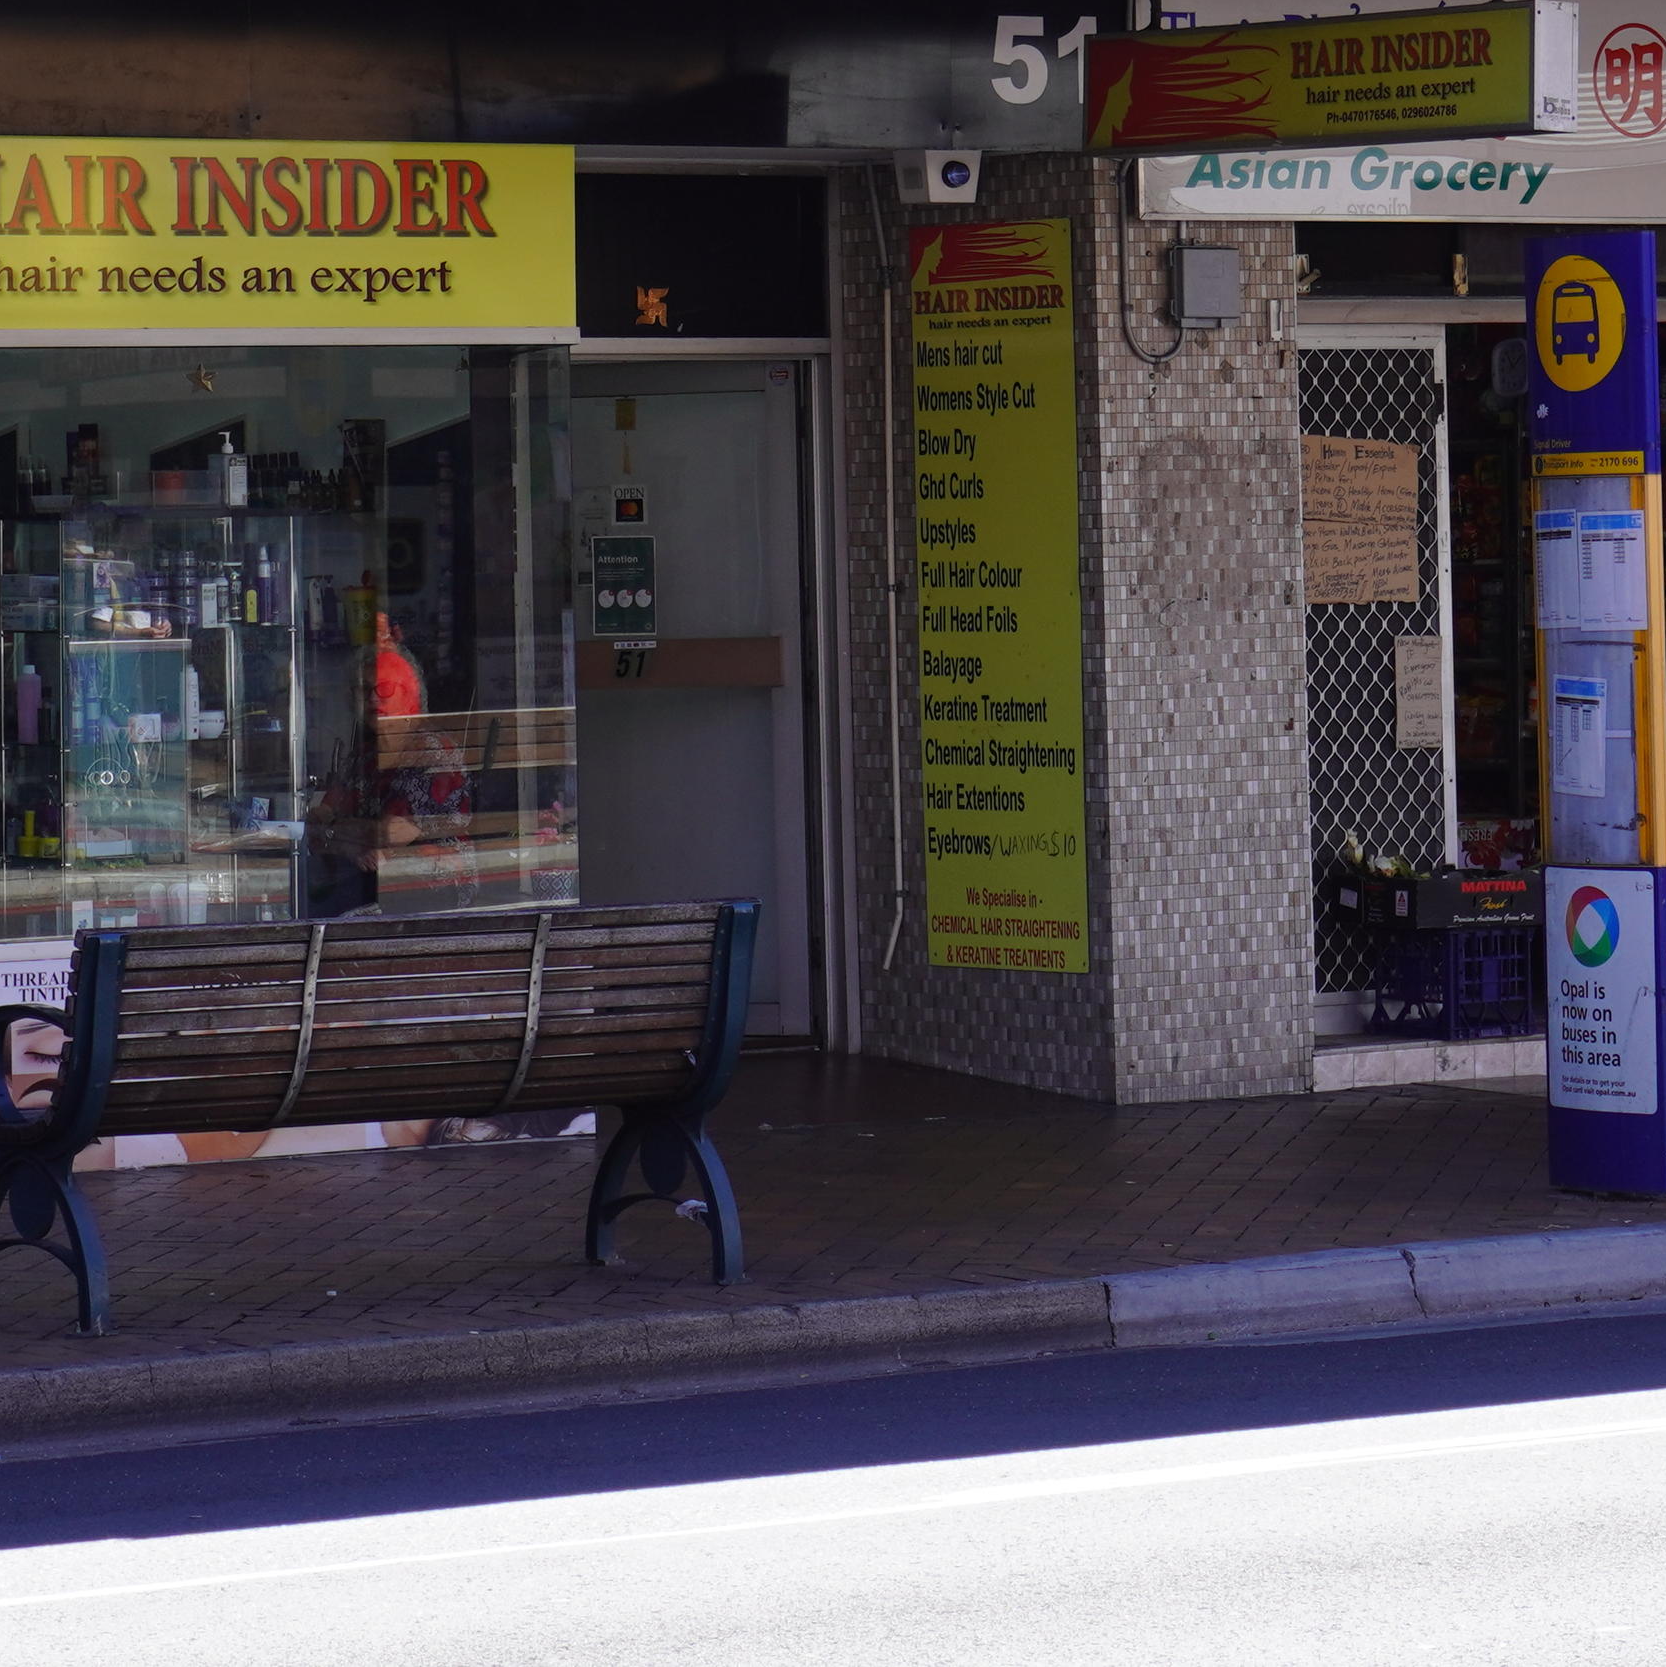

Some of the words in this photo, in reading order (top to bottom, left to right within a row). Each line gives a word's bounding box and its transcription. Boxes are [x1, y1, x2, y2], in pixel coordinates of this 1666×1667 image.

[989, 15, 1097, 105] 51
[1290, 40, 1365, 80] HAIR
[1372, 27, 1493, 73] INSIDER
[1305, 85, 1339, 106] hair
[1344, 80, 1391, 103] needs
[1395, 82, 1416, 101] an
[1421, 76, 1476, 102] expert
[1604, 42, 1663, 122] 明
[1185, 149, 1331, 190] Asian
[1350, 146, 1554, 204] Grocery
[170, 156, 496, 238] INSIDER
[98, 255, 226, 297] needs
[242, 265, 294, 295] an
[310, 258, 451, 304] expert
[916, 341, 951, 368] Mens
[953, 339, 979, 367] hair
[982, 339, 1003, 366] cut
[916, 385, 973, 412] Womens
[976, 382, 1009, 417] Style
[1013, 381, 1036, 410] Cut
[918, 429, 952, 457] Blow
[954, 427, 977, 462] Dry
[919, 517, 976, 551] Upstyles
[921, 562, 946, 589] Full
[949, 561, 976, 589] Hair
[978, 560, 1023, 589] Colour
[922, 649, 983, 685] Balayage
[924, 694, 978, 722] Keratine
[981, 694, 1048, 723] Treatment
[925, 738, 985, 766] Chemical
[988, 738, 1076, 775] Straightening
[926, 782, 953, 810] Hair
[956, 782, 1026, 813] Extentions
[1560, 979, 1590, 1002] Opal
[1593, 981, 1606, 1000] is
[1561, 1005, 1588, 1022] now
[1591, 1005, 1613, 1023] on
[1562, 1023, 1597, 1044] buses
[1602, 1027, 1617, 1045] in
[1561, 1045, 1584, 1066] this
[1587, 1049, 1622, 1068] area
